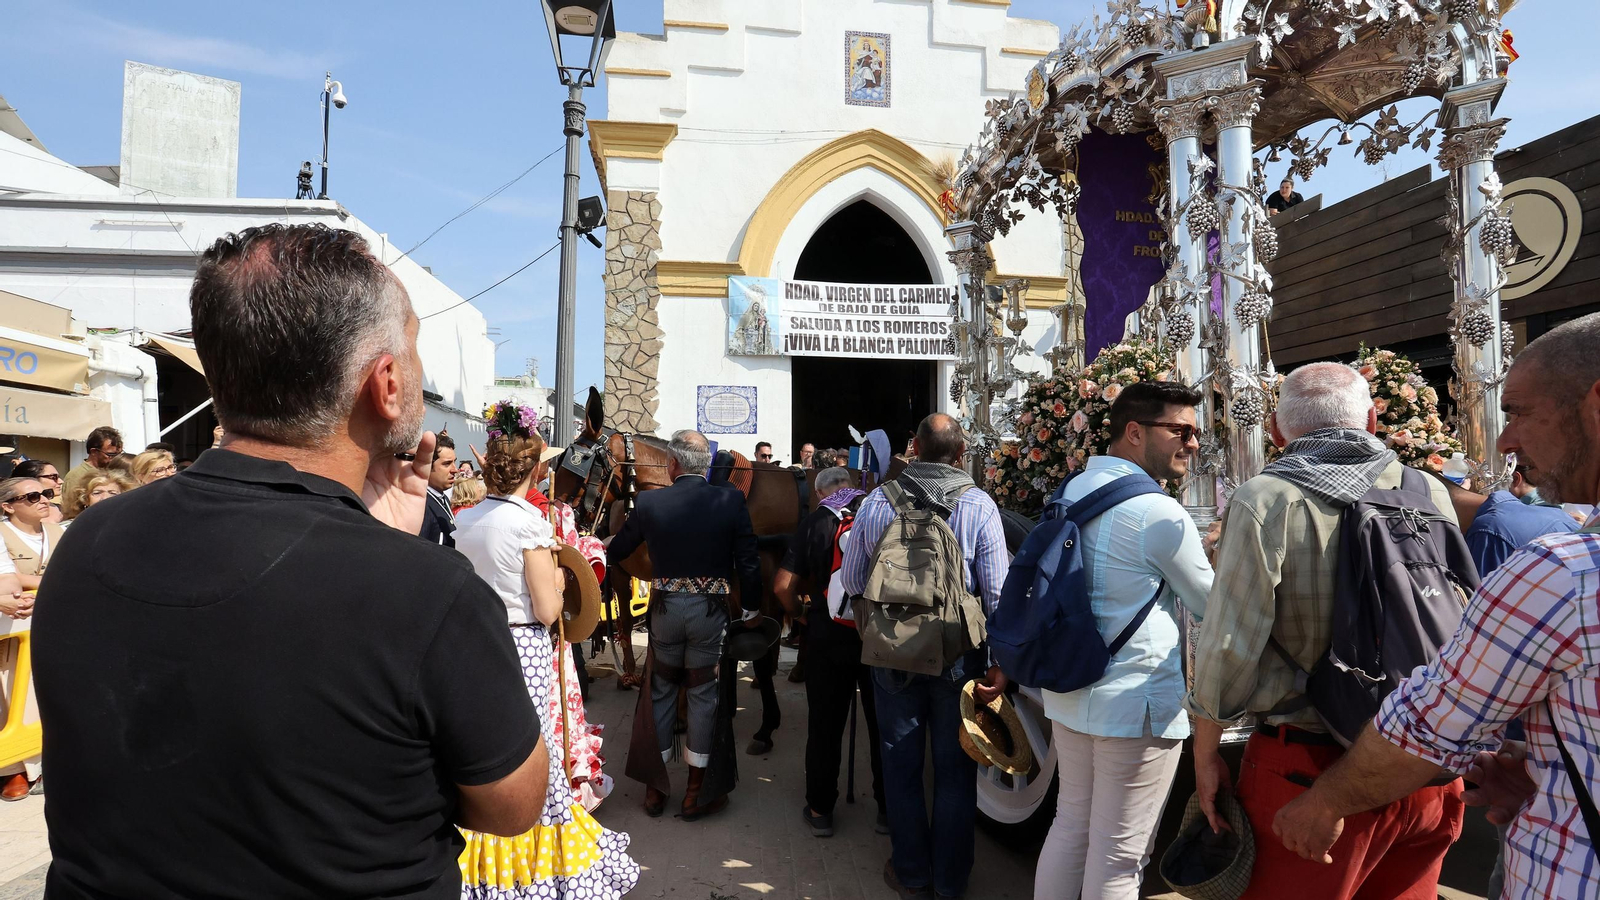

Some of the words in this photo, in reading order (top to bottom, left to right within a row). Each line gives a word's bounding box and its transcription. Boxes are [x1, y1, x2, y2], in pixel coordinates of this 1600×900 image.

[1115, 210, 1155, 224] HDAD.
[1148, 230, 1165, 241] DE
[1133, 245, 1162, 257] FRO
[784, 282, 823, 301] HDAD.
[825, 285, 871, 303] VIRGEN
[874, 287, 896, 304] DEL
[898, 287, 951, 304] CARMEN
[818, 303, 834, 313] DE
[837, 304, 869, 314] BAJO
[871, 304, 887, 314] DE
[790, 316, 843, 332] SALUDA
[844, 319, 854, 332] A
[856, 320, 880, 333] LOS
[883, 320, 948, 335] ROMEROS
[784, 333, 821, 353] ¡VIVA
[824, 334, 840, 352] LA
[842, 335, 895, 354] BLANCA
